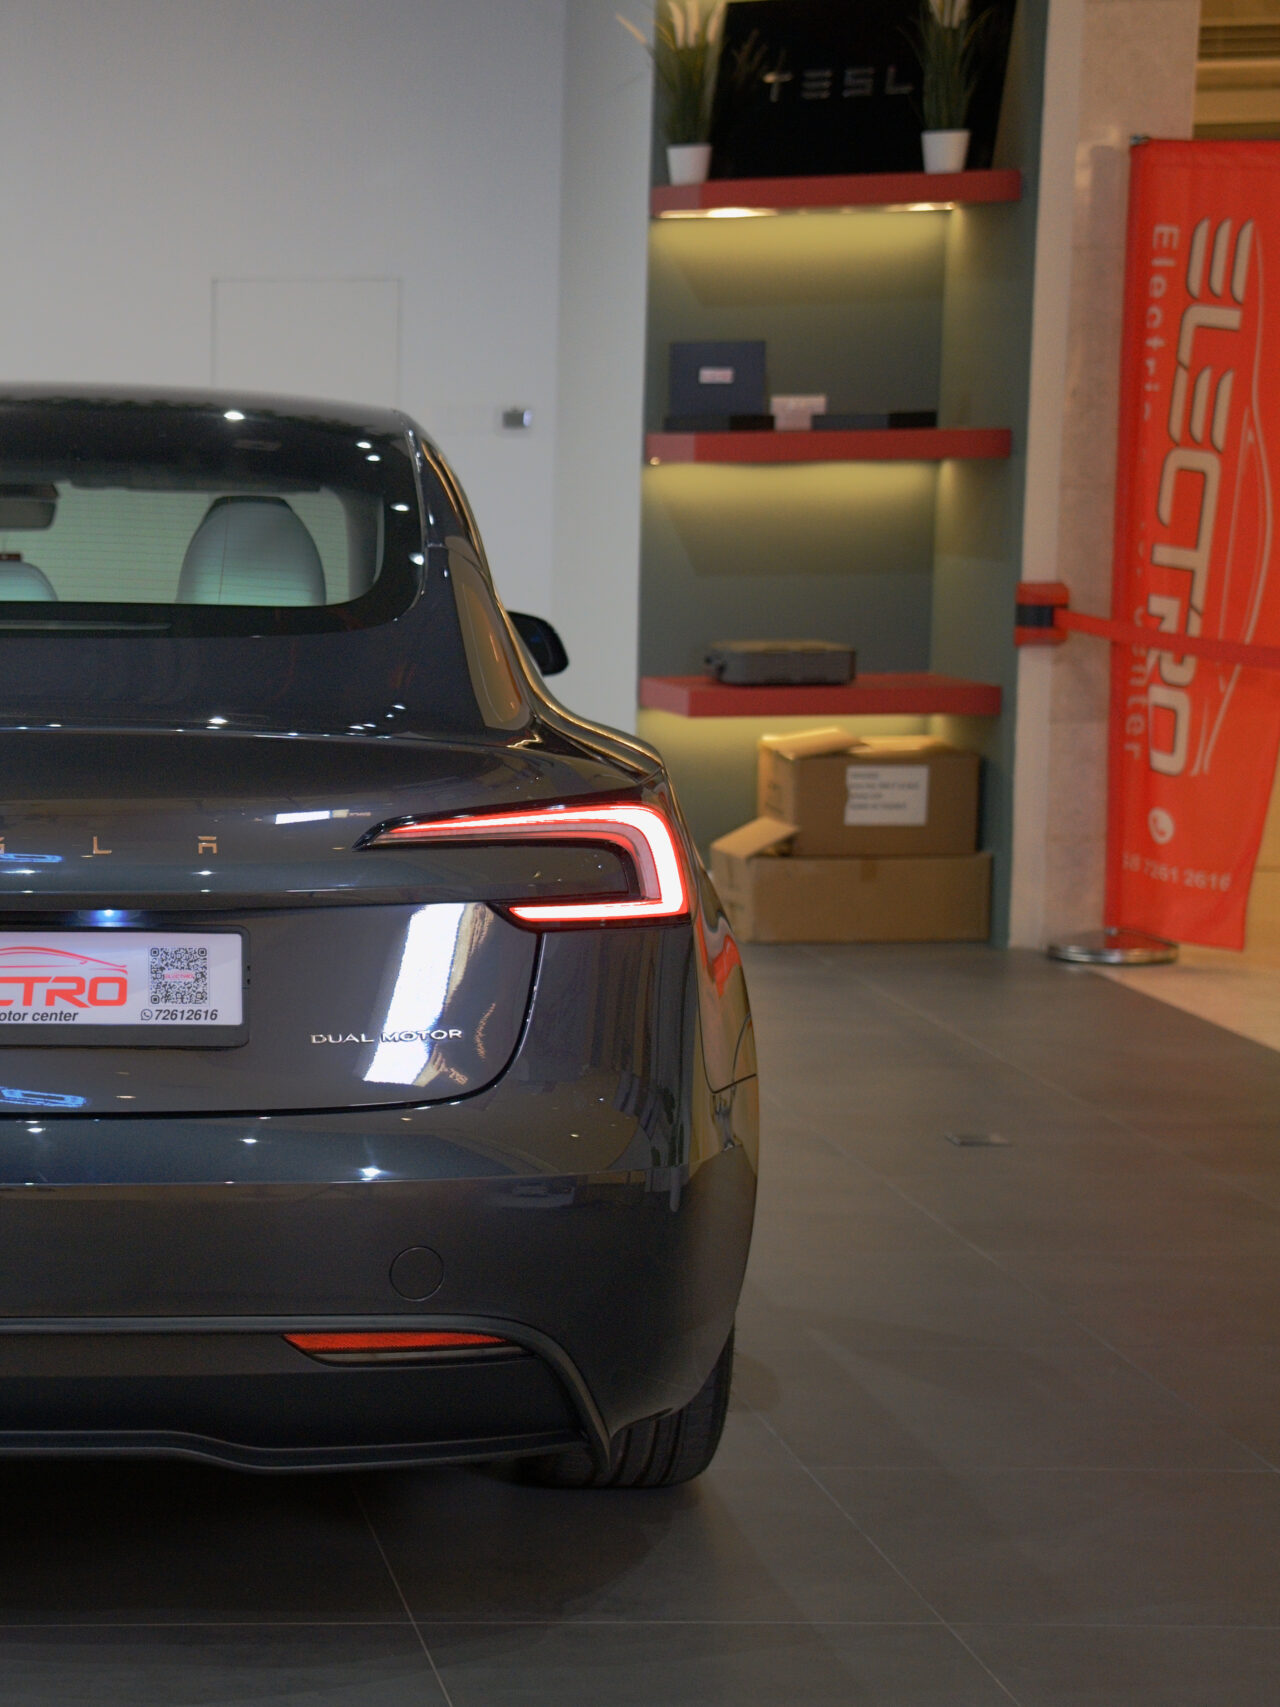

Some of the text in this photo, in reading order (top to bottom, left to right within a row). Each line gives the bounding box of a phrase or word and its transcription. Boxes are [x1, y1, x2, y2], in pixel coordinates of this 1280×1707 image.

[763, 65, 915, 102] TESL
[31, 1011, 79, 1022] center
[155, 1009, 219, 1021] 72612616
[310, 1029, 462, 1044] DUAL MOTOR
